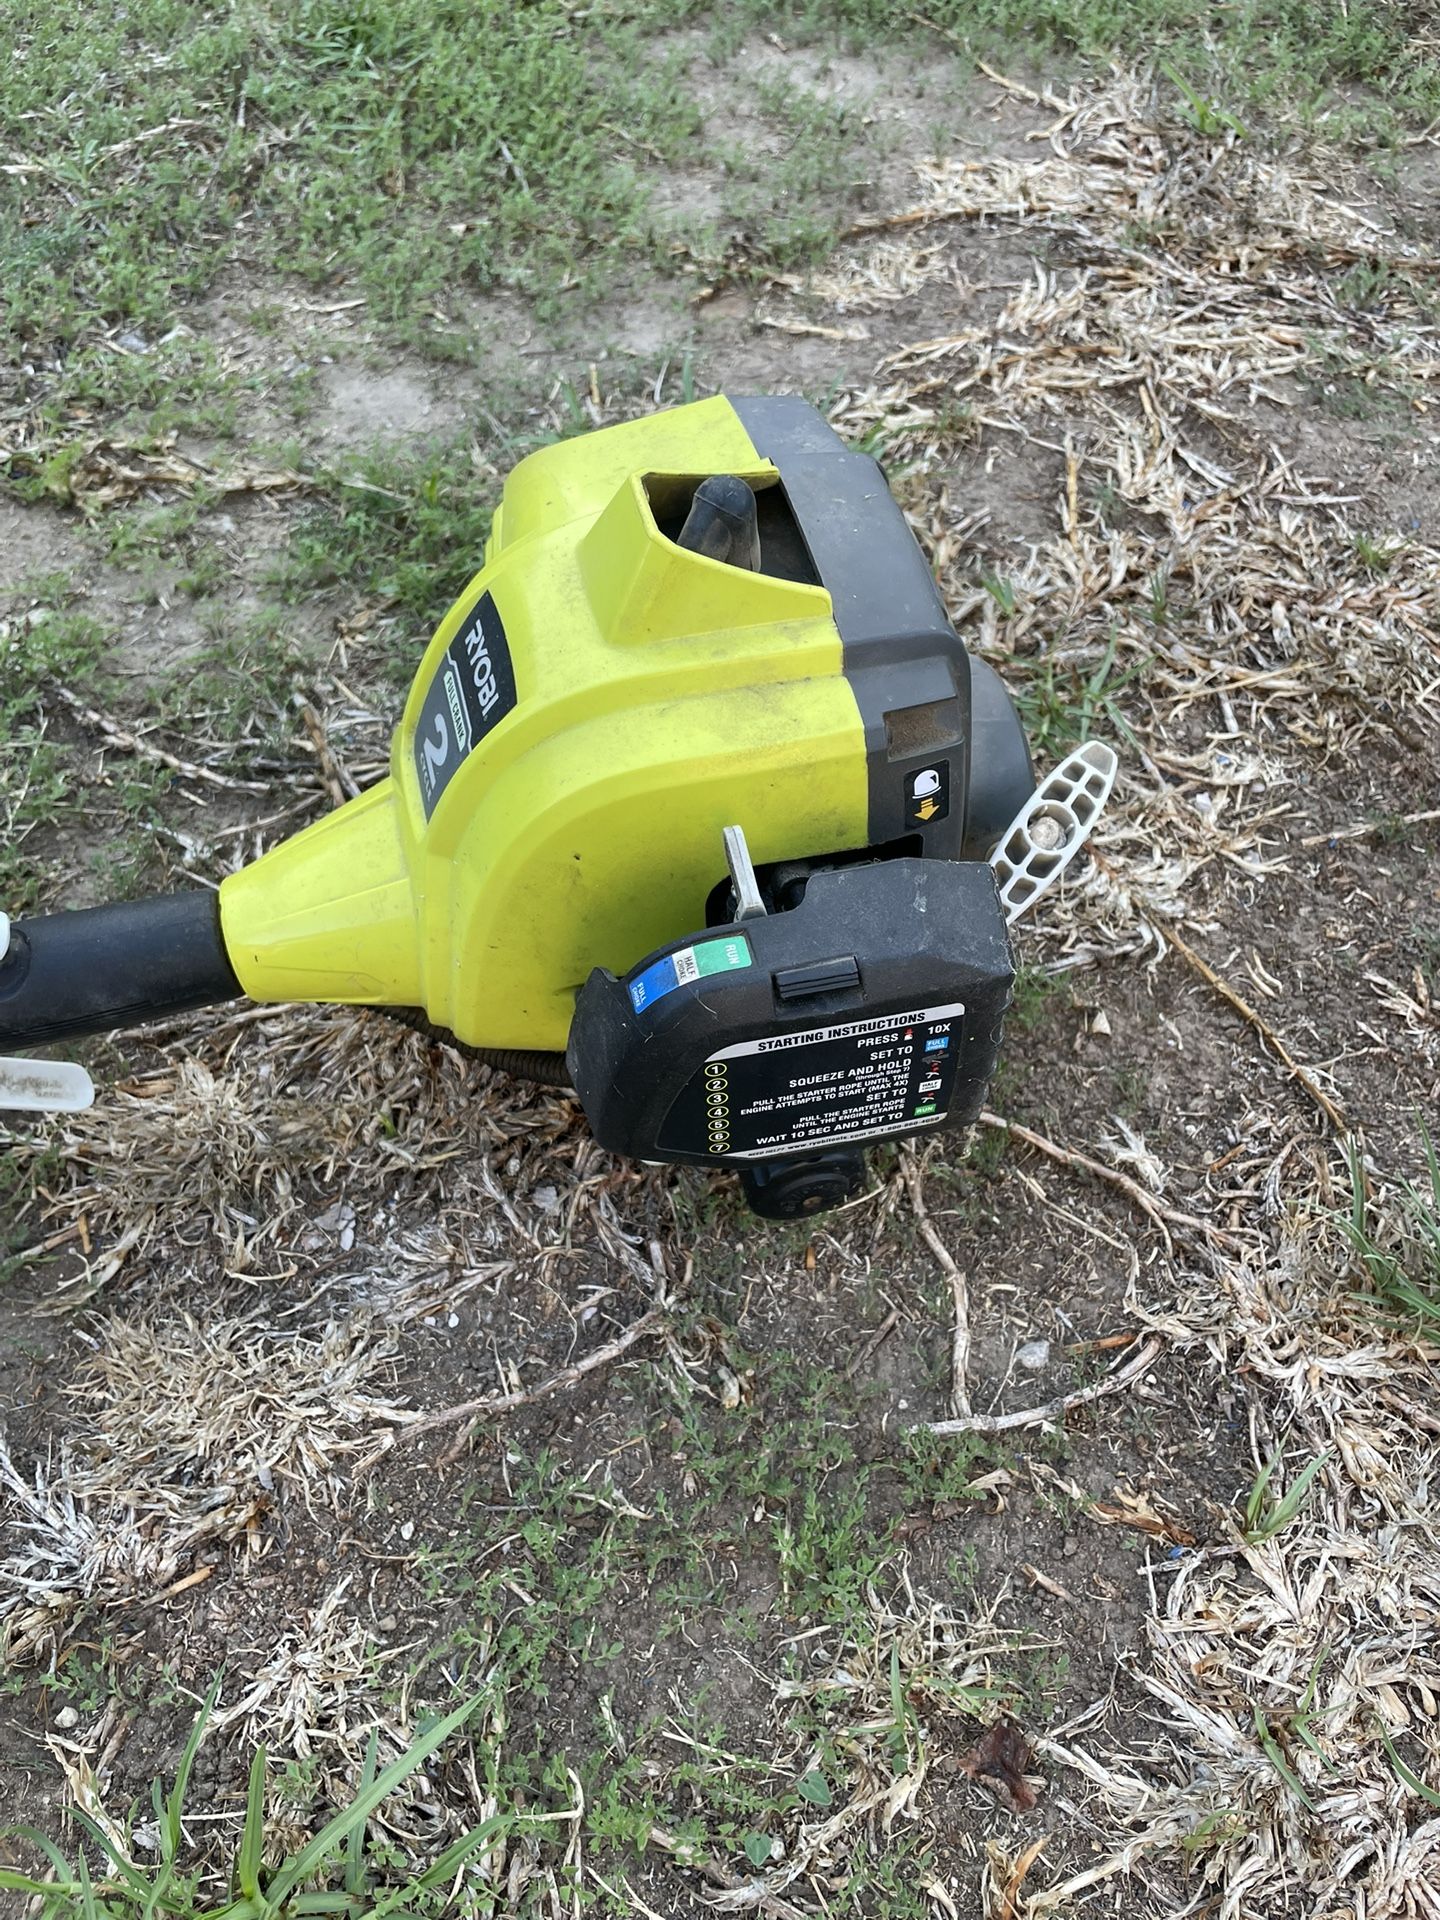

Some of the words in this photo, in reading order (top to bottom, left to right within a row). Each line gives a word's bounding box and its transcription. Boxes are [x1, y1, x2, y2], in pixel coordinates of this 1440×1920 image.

[465, 619, 499, 716] RYOBI
[446, 676, 457, 701] FULL
[452, 703, 464, 738] CRANK
[424, 713, 448, 789] 2
[684, 955, 696, 975] HALF
[725, 943, 740, 965] RUN
[637, 982, 647, 1004] FULL
[758, 1032, 823, 1051] STARTING
[828, 1012, 926, 1039] INSTRUCTIONS
[857, 1033, 899, 1048] PRESS
[928, 1023, 951, 1035] 10X
[927, 1038, 945, 1046] FULL
[870, 1049, 893, 1061] SET
[895, 1046, 913, 1055] TO
[789, 1070, 845, 1088] SQUEEZE
[848, 1065, 874, 1077] AND
[878, 1058, 912, 1072] HOLD
[855, 1072, 885, 1082] (through
[740, 1105, 773, 1115] ENGINE
[775, 1096, 822, 1110] ATTEMPTS
[838, 1088, 866, 1098] START
[868, 1083, 892, 1093] (MAX
[893, 1079, 909, 1088] 4X)
[752, 1098, 775, 1107] PULL
[778, 1094, 795, 1102] THE
[797, 1087, 836, 1098] STARTER
[839, 1082, 863, 1092] ROPE
[865, 1077, 890, 1086] UNTIL
[892, 1073, 910, 1081] THE
[866, 1092, 888, 1102] SET
[890, 1088, 907, 1097] TO
[792, 1120, 818, 1129] UNTIL
[819, 1116, 837, 1125] THE
[838, 1110, 871, 1121] ENGINE
[872, 1104, 905, 1114] STARTS
[799, 1114, 823, 1123] PULL
[824, 1111, 841, 1119] THE
[842, 1103, 881, 1115] STARTER
[882, 1098, 906, 1106] ROPE
[917, 1106, 933, 1114] RUN
[756, 1134, 787, 1145] WAIT
[791, 1131, 805, 1139] 10
[808, 1126, 831, 1136] SEC
[834, 1121, 859, 1131] AND
[862, 1116, 884, 1126] SET
[887, 1112, 903, 1120] TO
